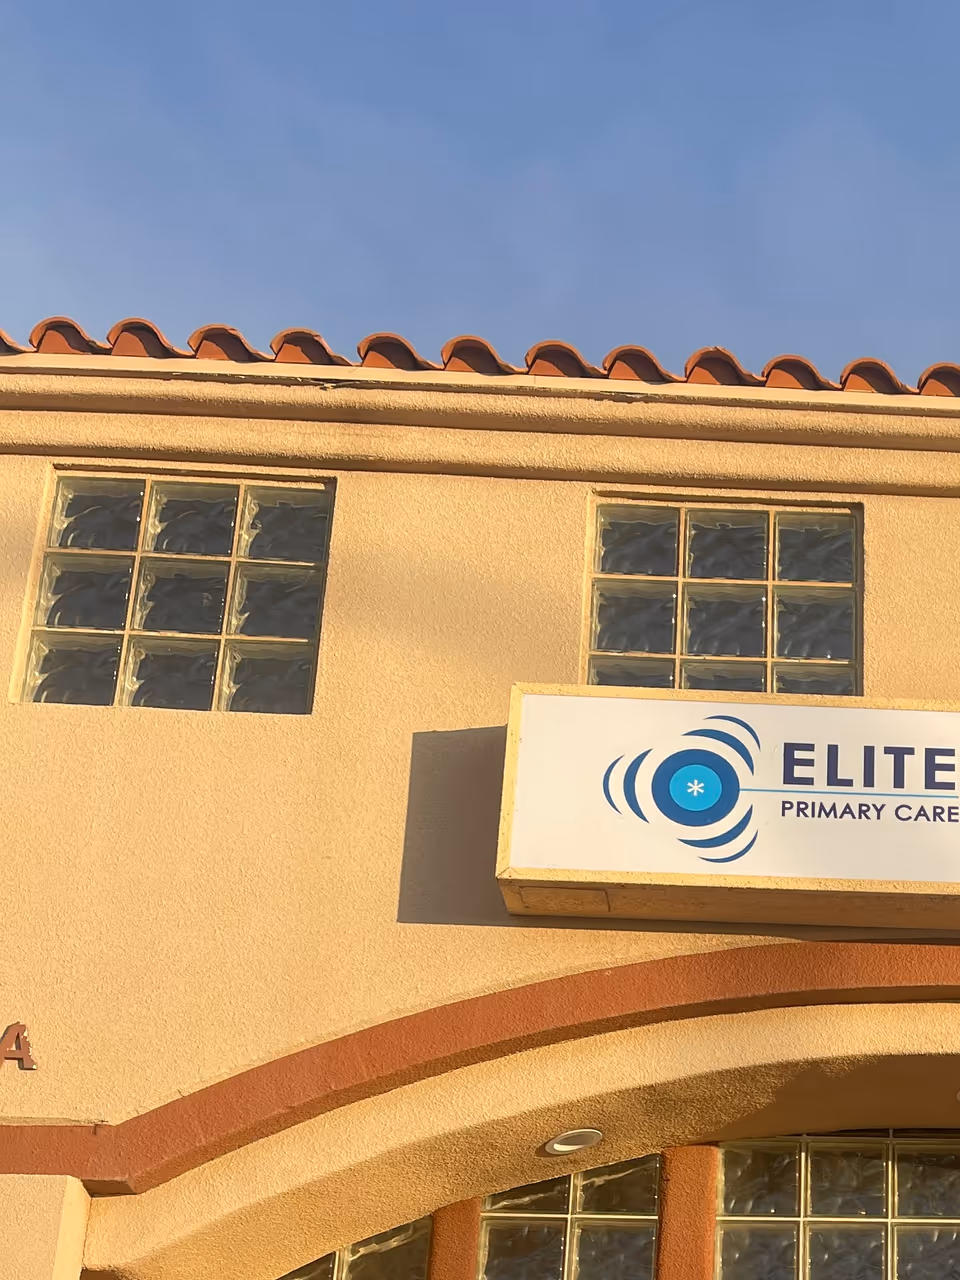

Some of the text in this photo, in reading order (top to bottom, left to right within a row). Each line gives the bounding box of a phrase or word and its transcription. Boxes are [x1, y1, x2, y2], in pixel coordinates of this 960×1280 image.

[783, 742, 956, 791] ELITE
[781, 800, 959, 823] PRIMARY CARE
